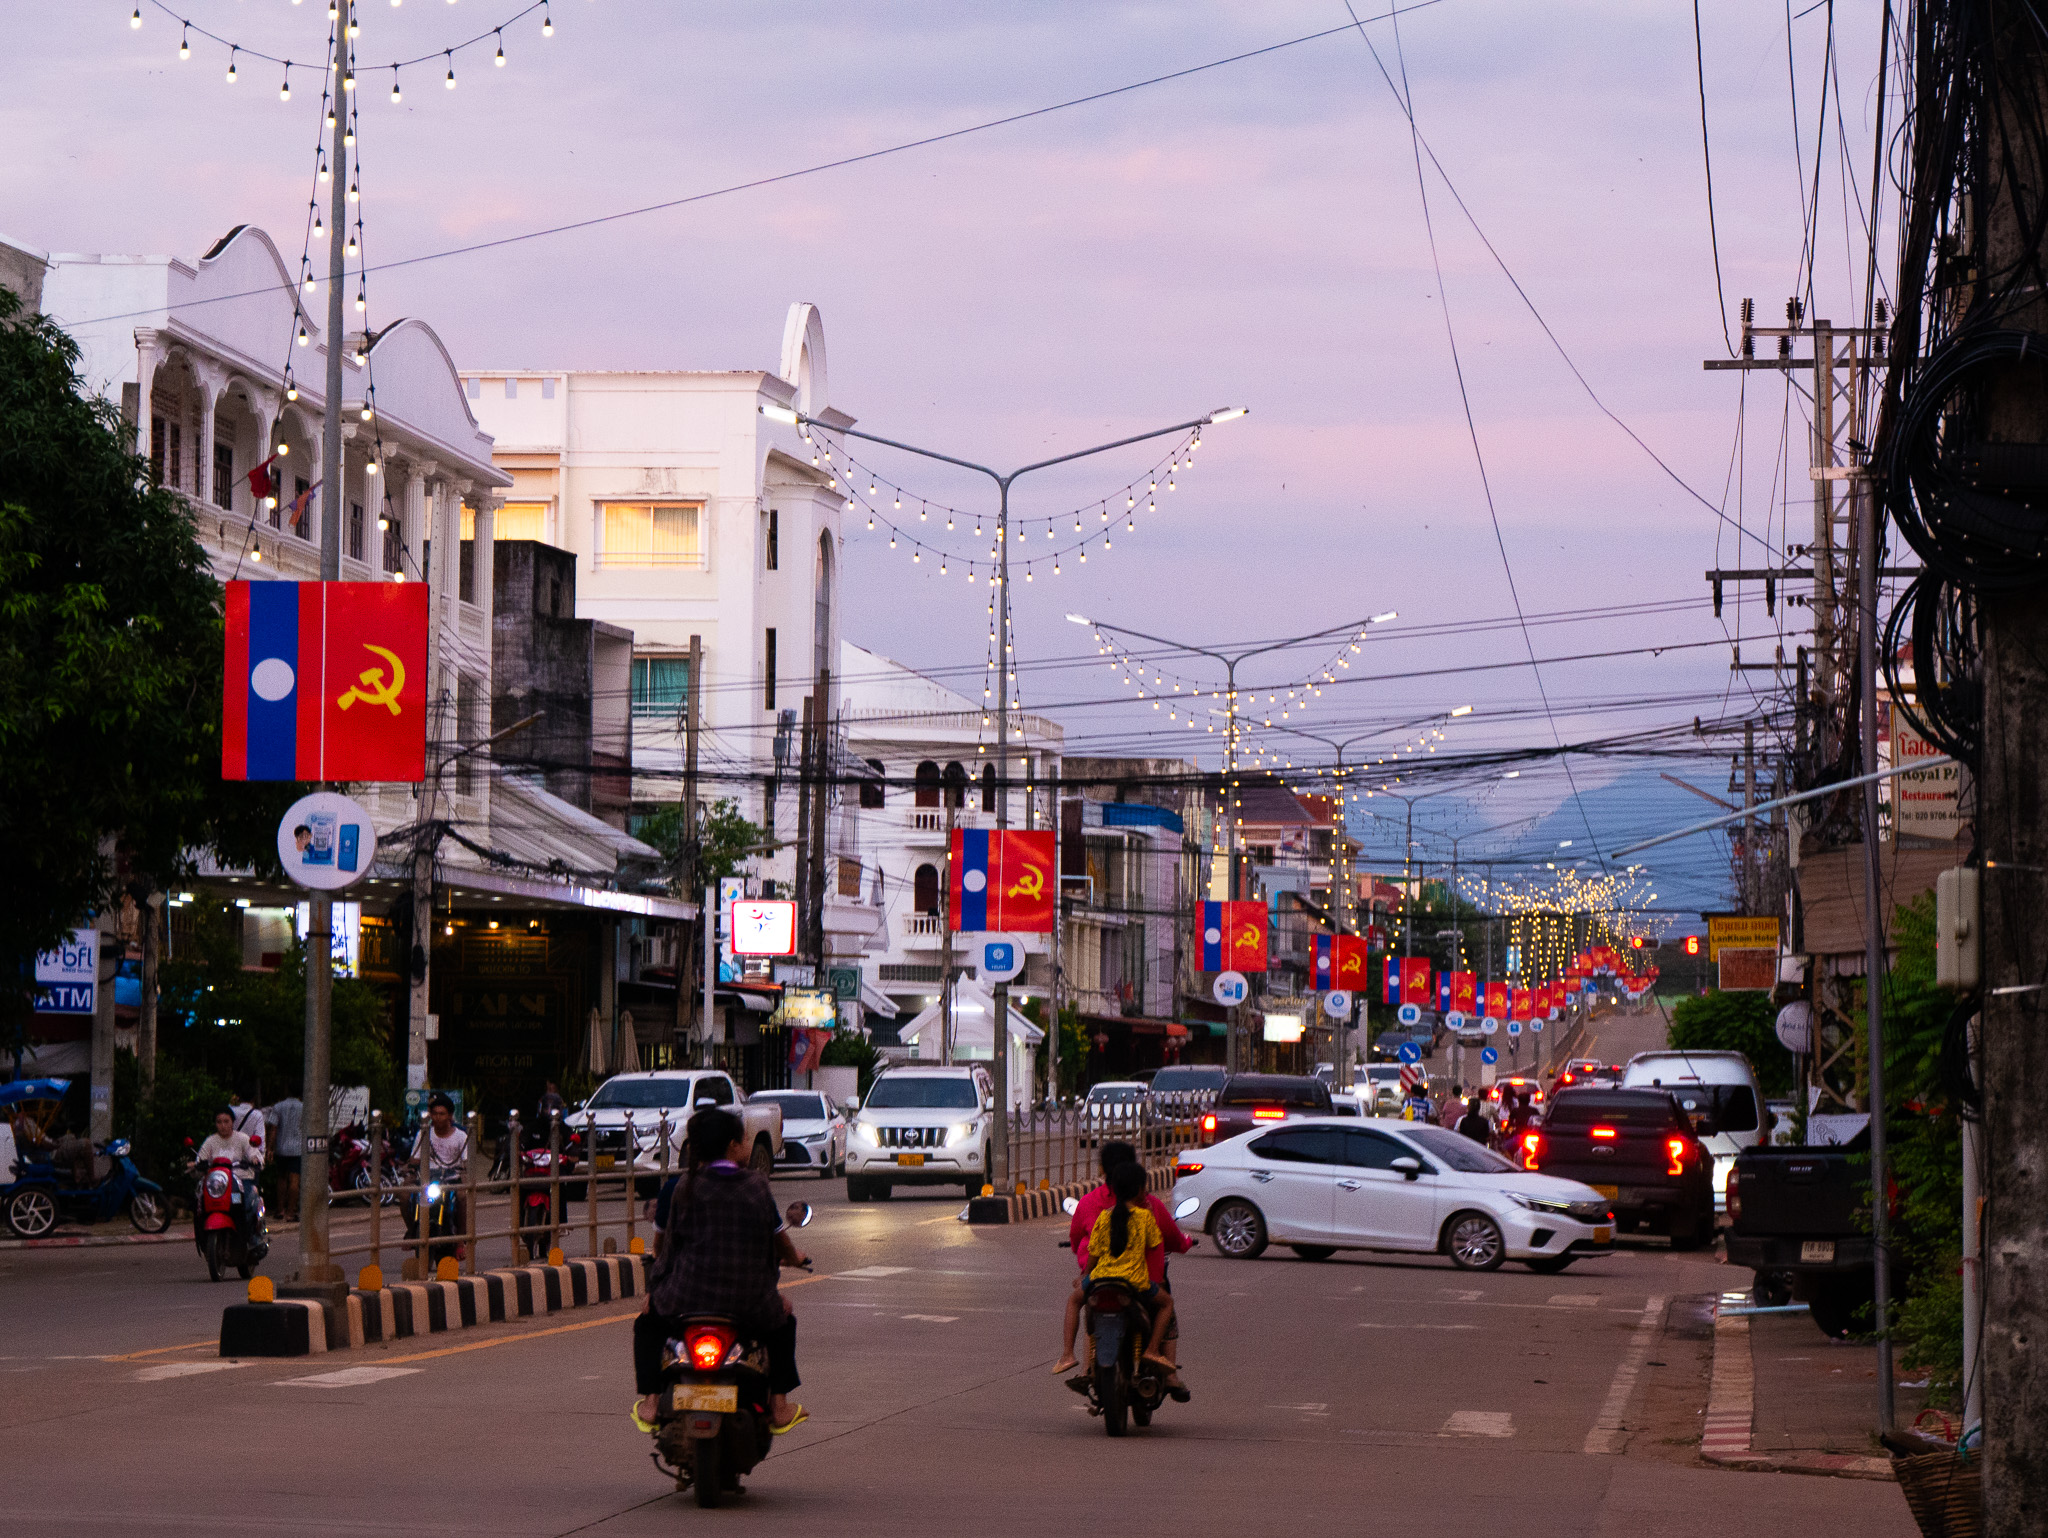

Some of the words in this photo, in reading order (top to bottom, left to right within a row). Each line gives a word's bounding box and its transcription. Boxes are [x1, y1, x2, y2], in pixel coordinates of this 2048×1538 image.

[1902, 768, 1940, 783] Royal
[1915, 811, 1929, 821] 020
[1686, 936, 1699, 955] 6
[37, 987, 91, 1008] ATM
